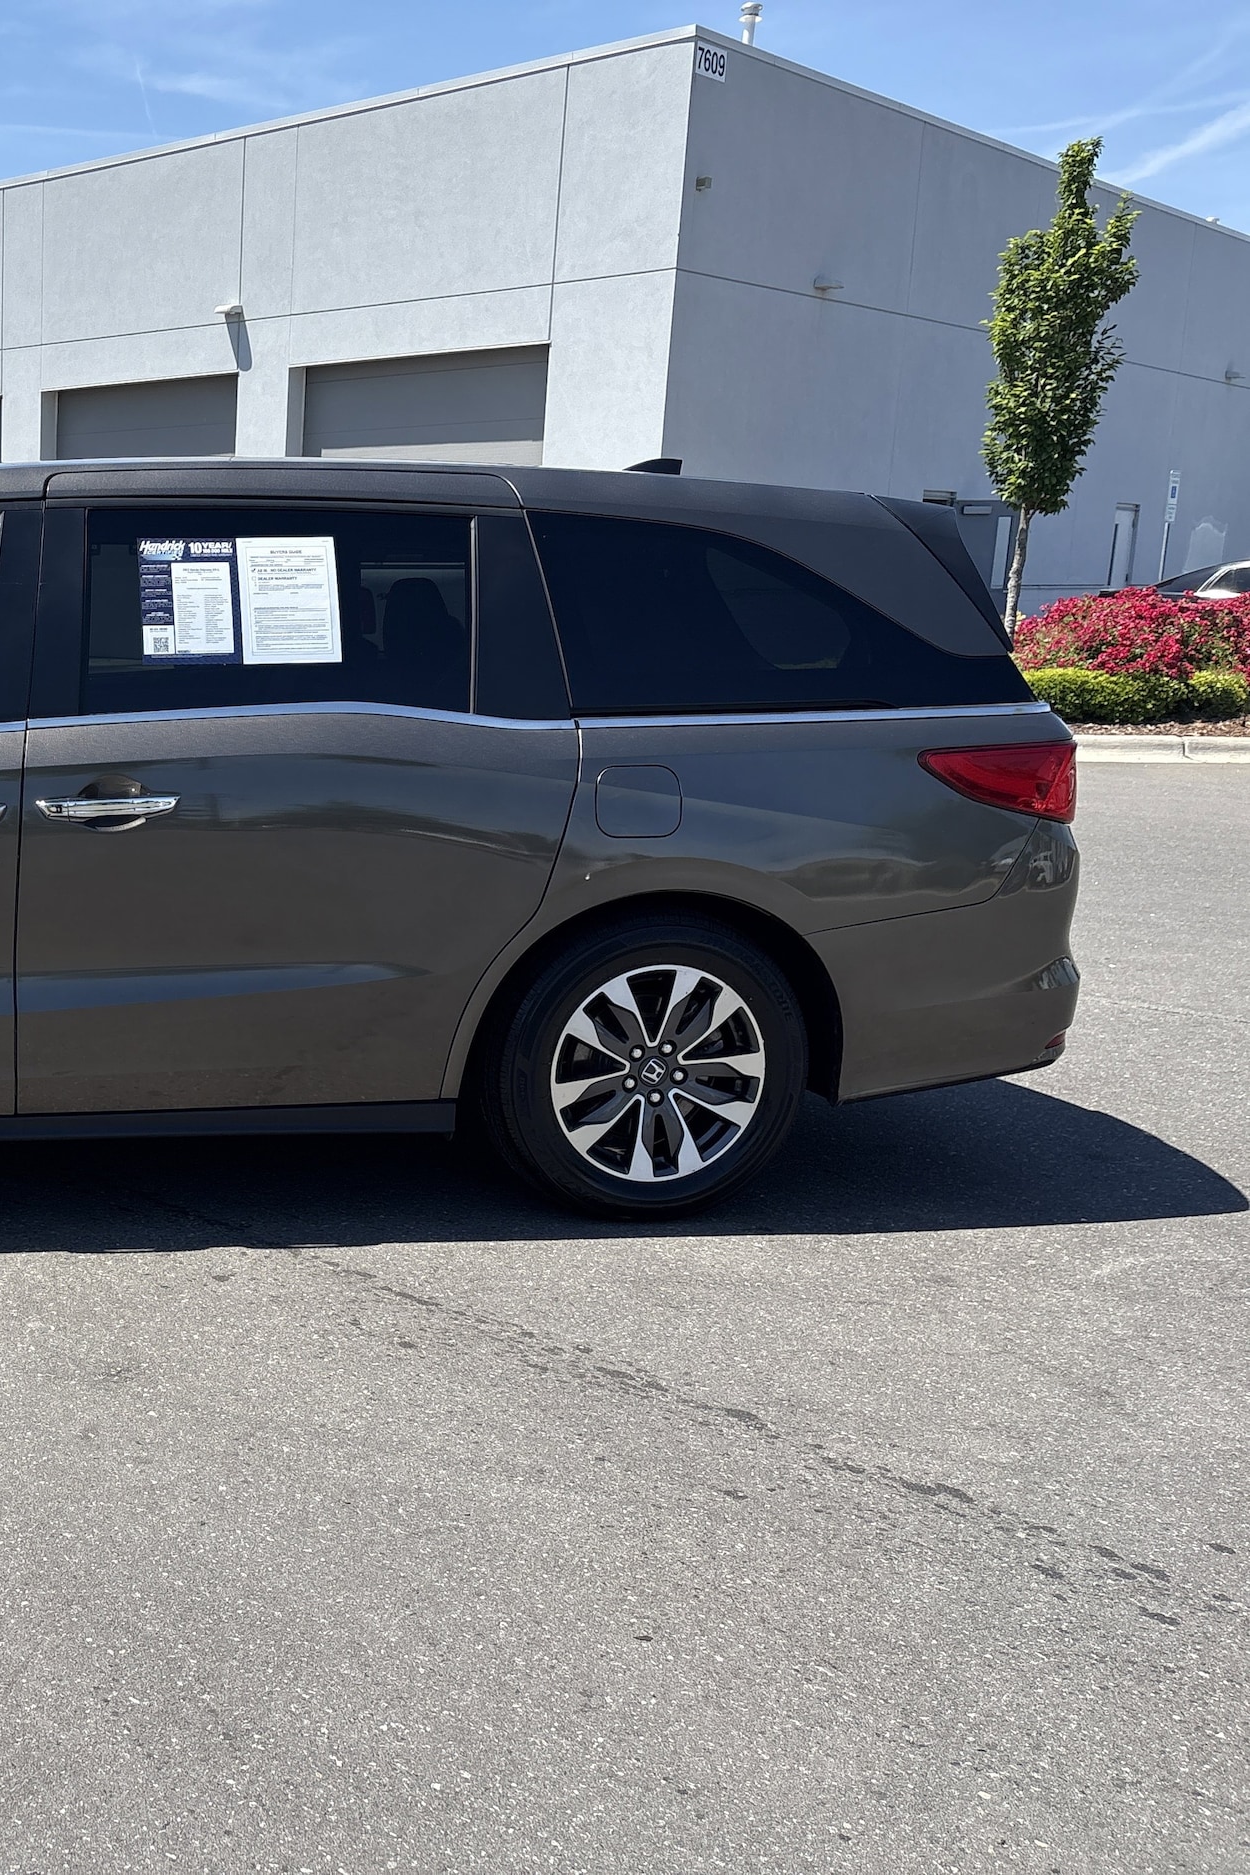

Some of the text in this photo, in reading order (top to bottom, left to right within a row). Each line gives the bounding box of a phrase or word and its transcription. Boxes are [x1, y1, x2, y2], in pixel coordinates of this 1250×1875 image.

[698, 46, 725, 77] 7609
[139, 540, 186, 555] Hendrick
[188, 542, 202, 554] 10
